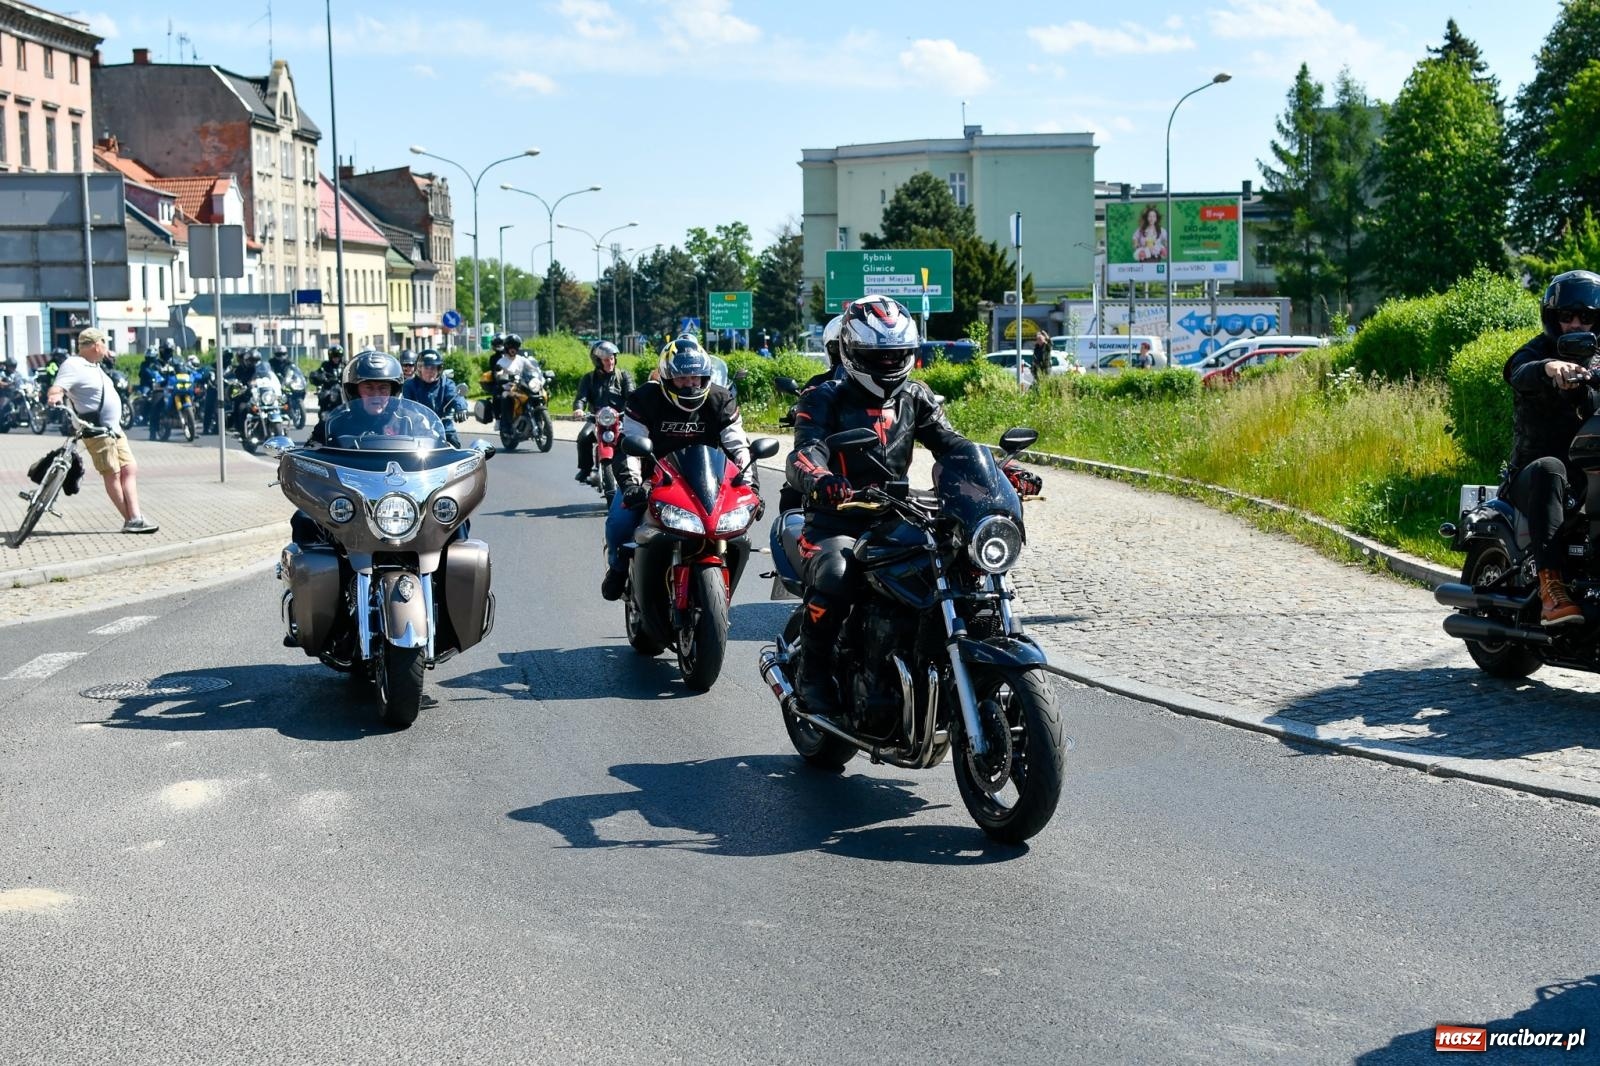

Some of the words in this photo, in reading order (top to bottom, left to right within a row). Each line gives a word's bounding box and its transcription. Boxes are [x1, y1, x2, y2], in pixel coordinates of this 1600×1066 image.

[863, 253, 892, 262] Rybnik
[862, 264, 896, 273] Gliwice
[889, 275, 913, 284] Miejski
[660, 421, 707, 433] FLM
